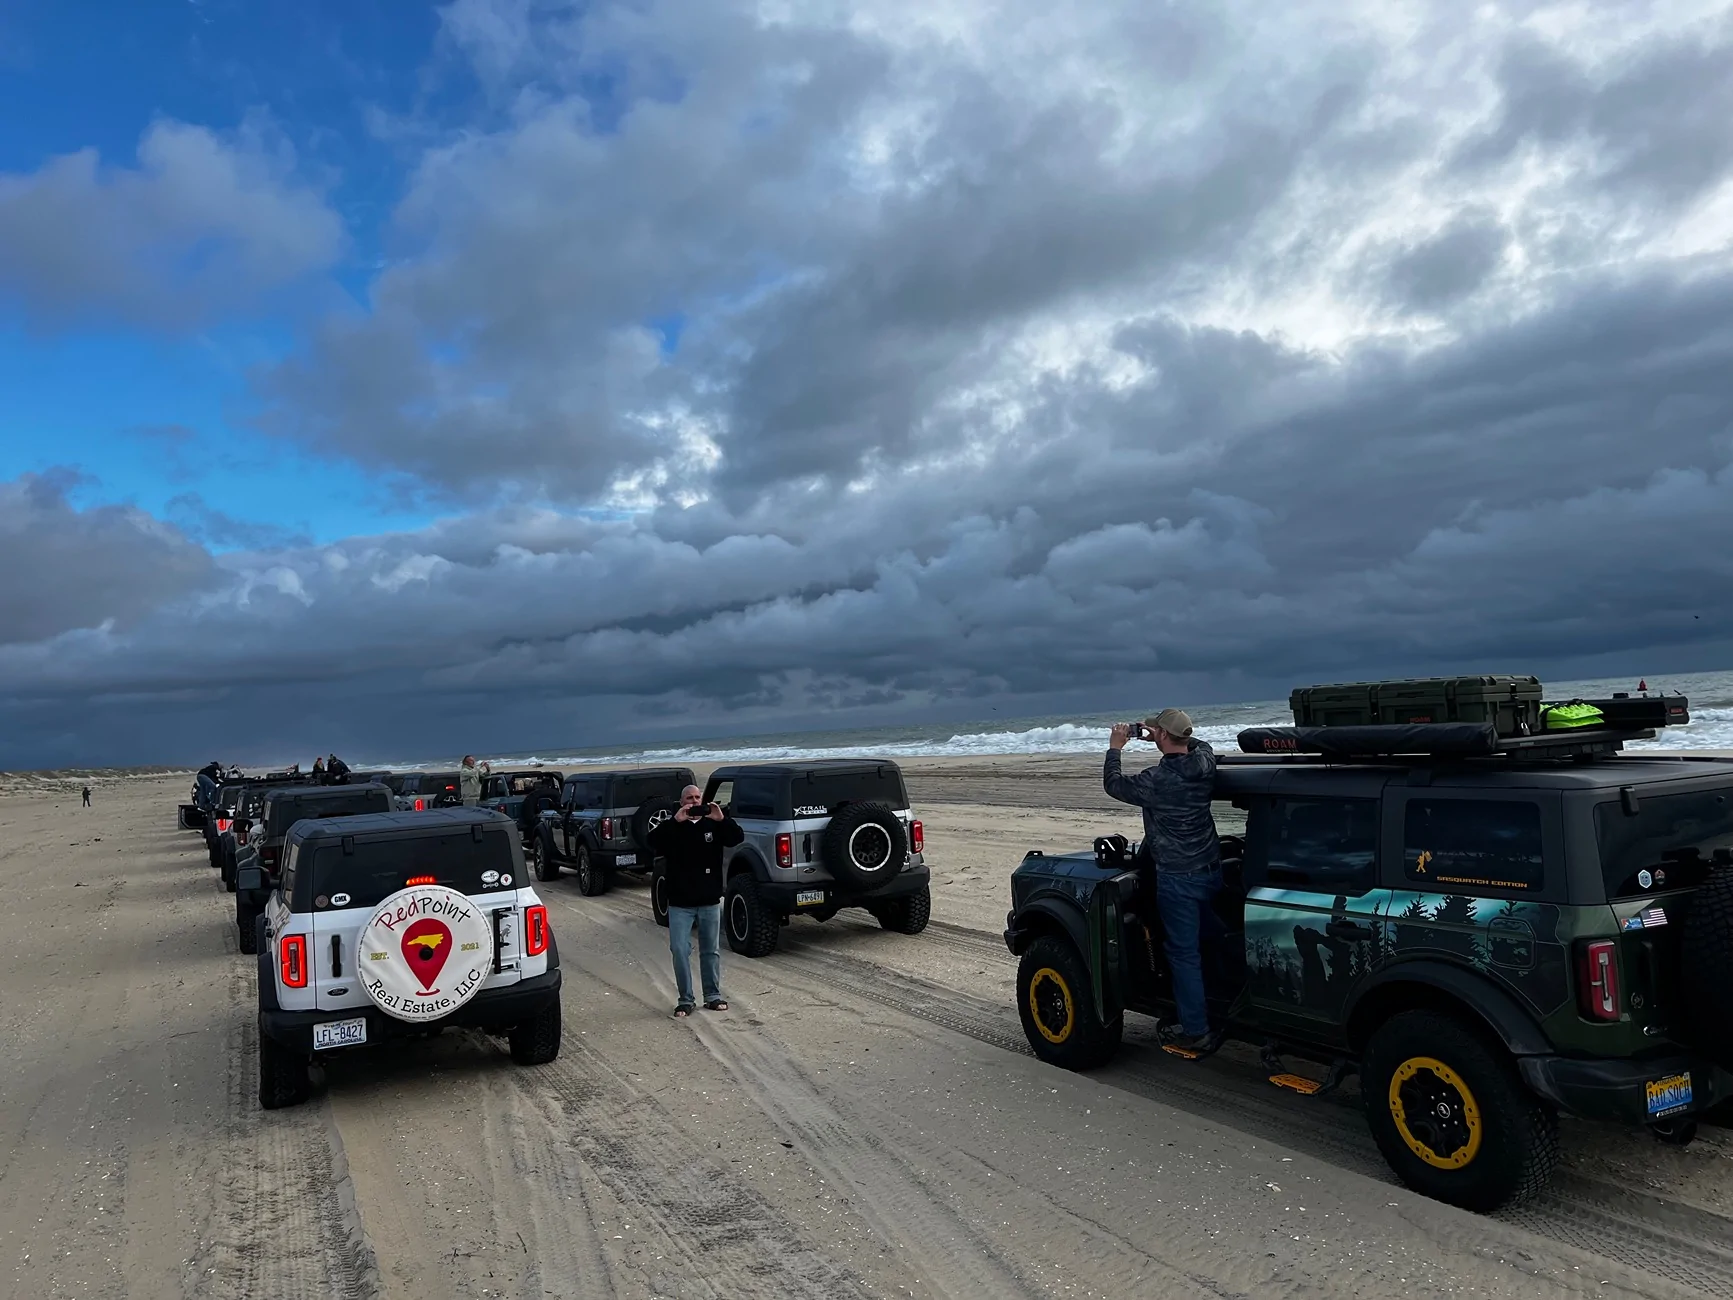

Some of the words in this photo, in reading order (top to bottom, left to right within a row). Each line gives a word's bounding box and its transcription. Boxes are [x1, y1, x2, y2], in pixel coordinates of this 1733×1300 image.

[1263, 738, 1297, 749] ROAM
[1436, 876, 1489, 885] SASQUATCH
[1491, 880, 1528, 888] EDITION
[461, 942, 480, 951] 2021
[368, 979, 400, 1008] Real
[400, 998, 456, 1013] Estate,
[454, 968, 481, 998] LLC
[316, 1024, 363, 1043] LFL-8427
[1649, 1087, 1666, 1108] BAD
